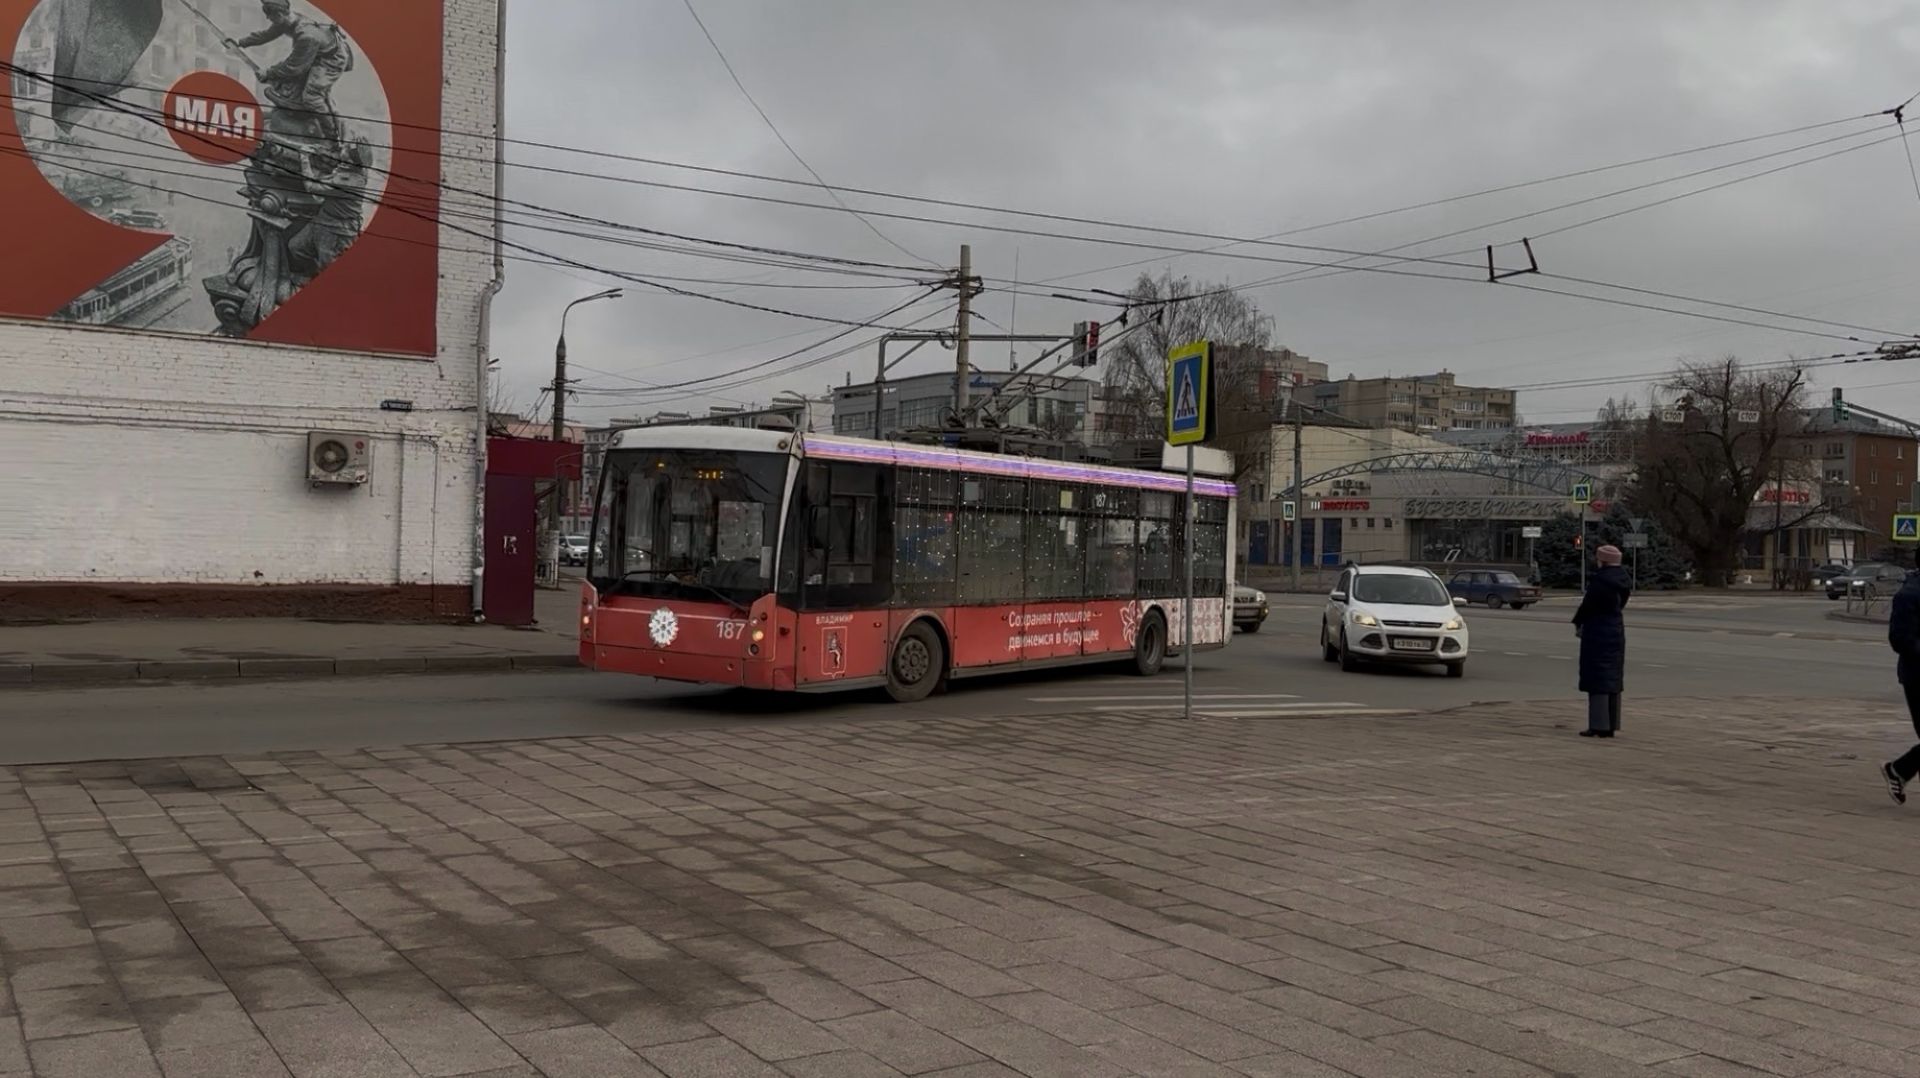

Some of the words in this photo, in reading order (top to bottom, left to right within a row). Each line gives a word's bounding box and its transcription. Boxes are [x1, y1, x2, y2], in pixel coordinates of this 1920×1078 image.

[175, 95, 255, 141] МАЯ
[815, 614, 854, 625] ВЛАДИМИР
[1009, 611, 1052, 630] Сохраняя
[1053, 610, 1091, 627] прошлое
[716, 621, 746, 640] 187
[1009, 633, 1054, 652] движемся
[1056, 632, 1061, 644] в
[1062, 628, 1100, 647] будущее
